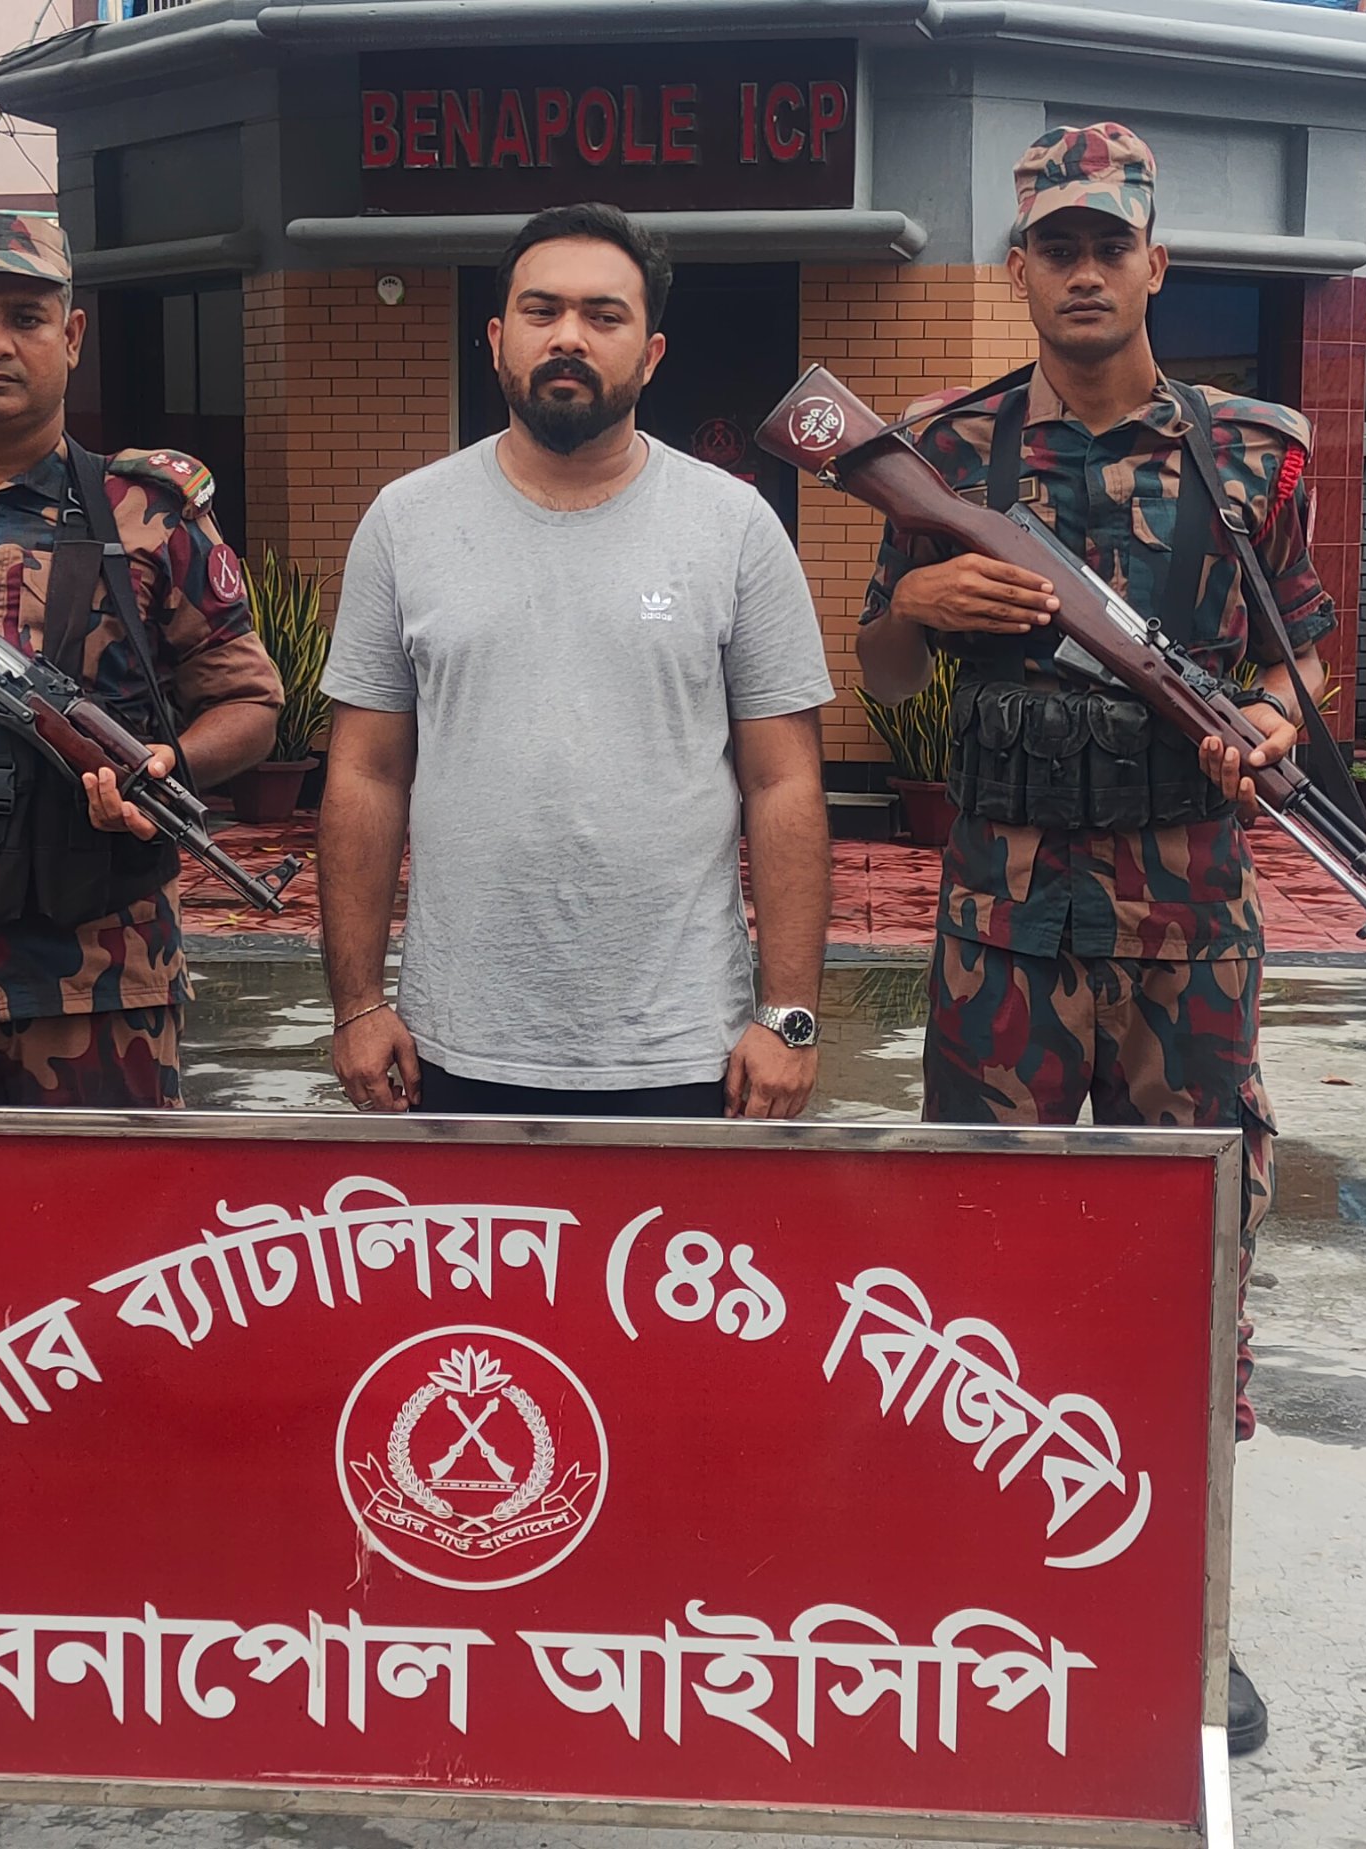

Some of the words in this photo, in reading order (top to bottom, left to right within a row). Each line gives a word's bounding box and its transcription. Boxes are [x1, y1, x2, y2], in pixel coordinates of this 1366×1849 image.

[361, 84, 698, 169] BENAPOLE
[738, 80, 849, 165] ICP
[88, 1175, 581, 1350] ব্যাটালিয়ন
[605, 1205, 787, 1341] (৪৯
[822, 1266, 1152, 1569] বিজিবি)
[376, 1504, 428, 1534] বর্ডার
[433, 1528, 474, 1551] গার্ড
[476, 1511, 571, 1551] বাংলাদেশ
[515, 1599, 1098, 1763] আইসিপি
